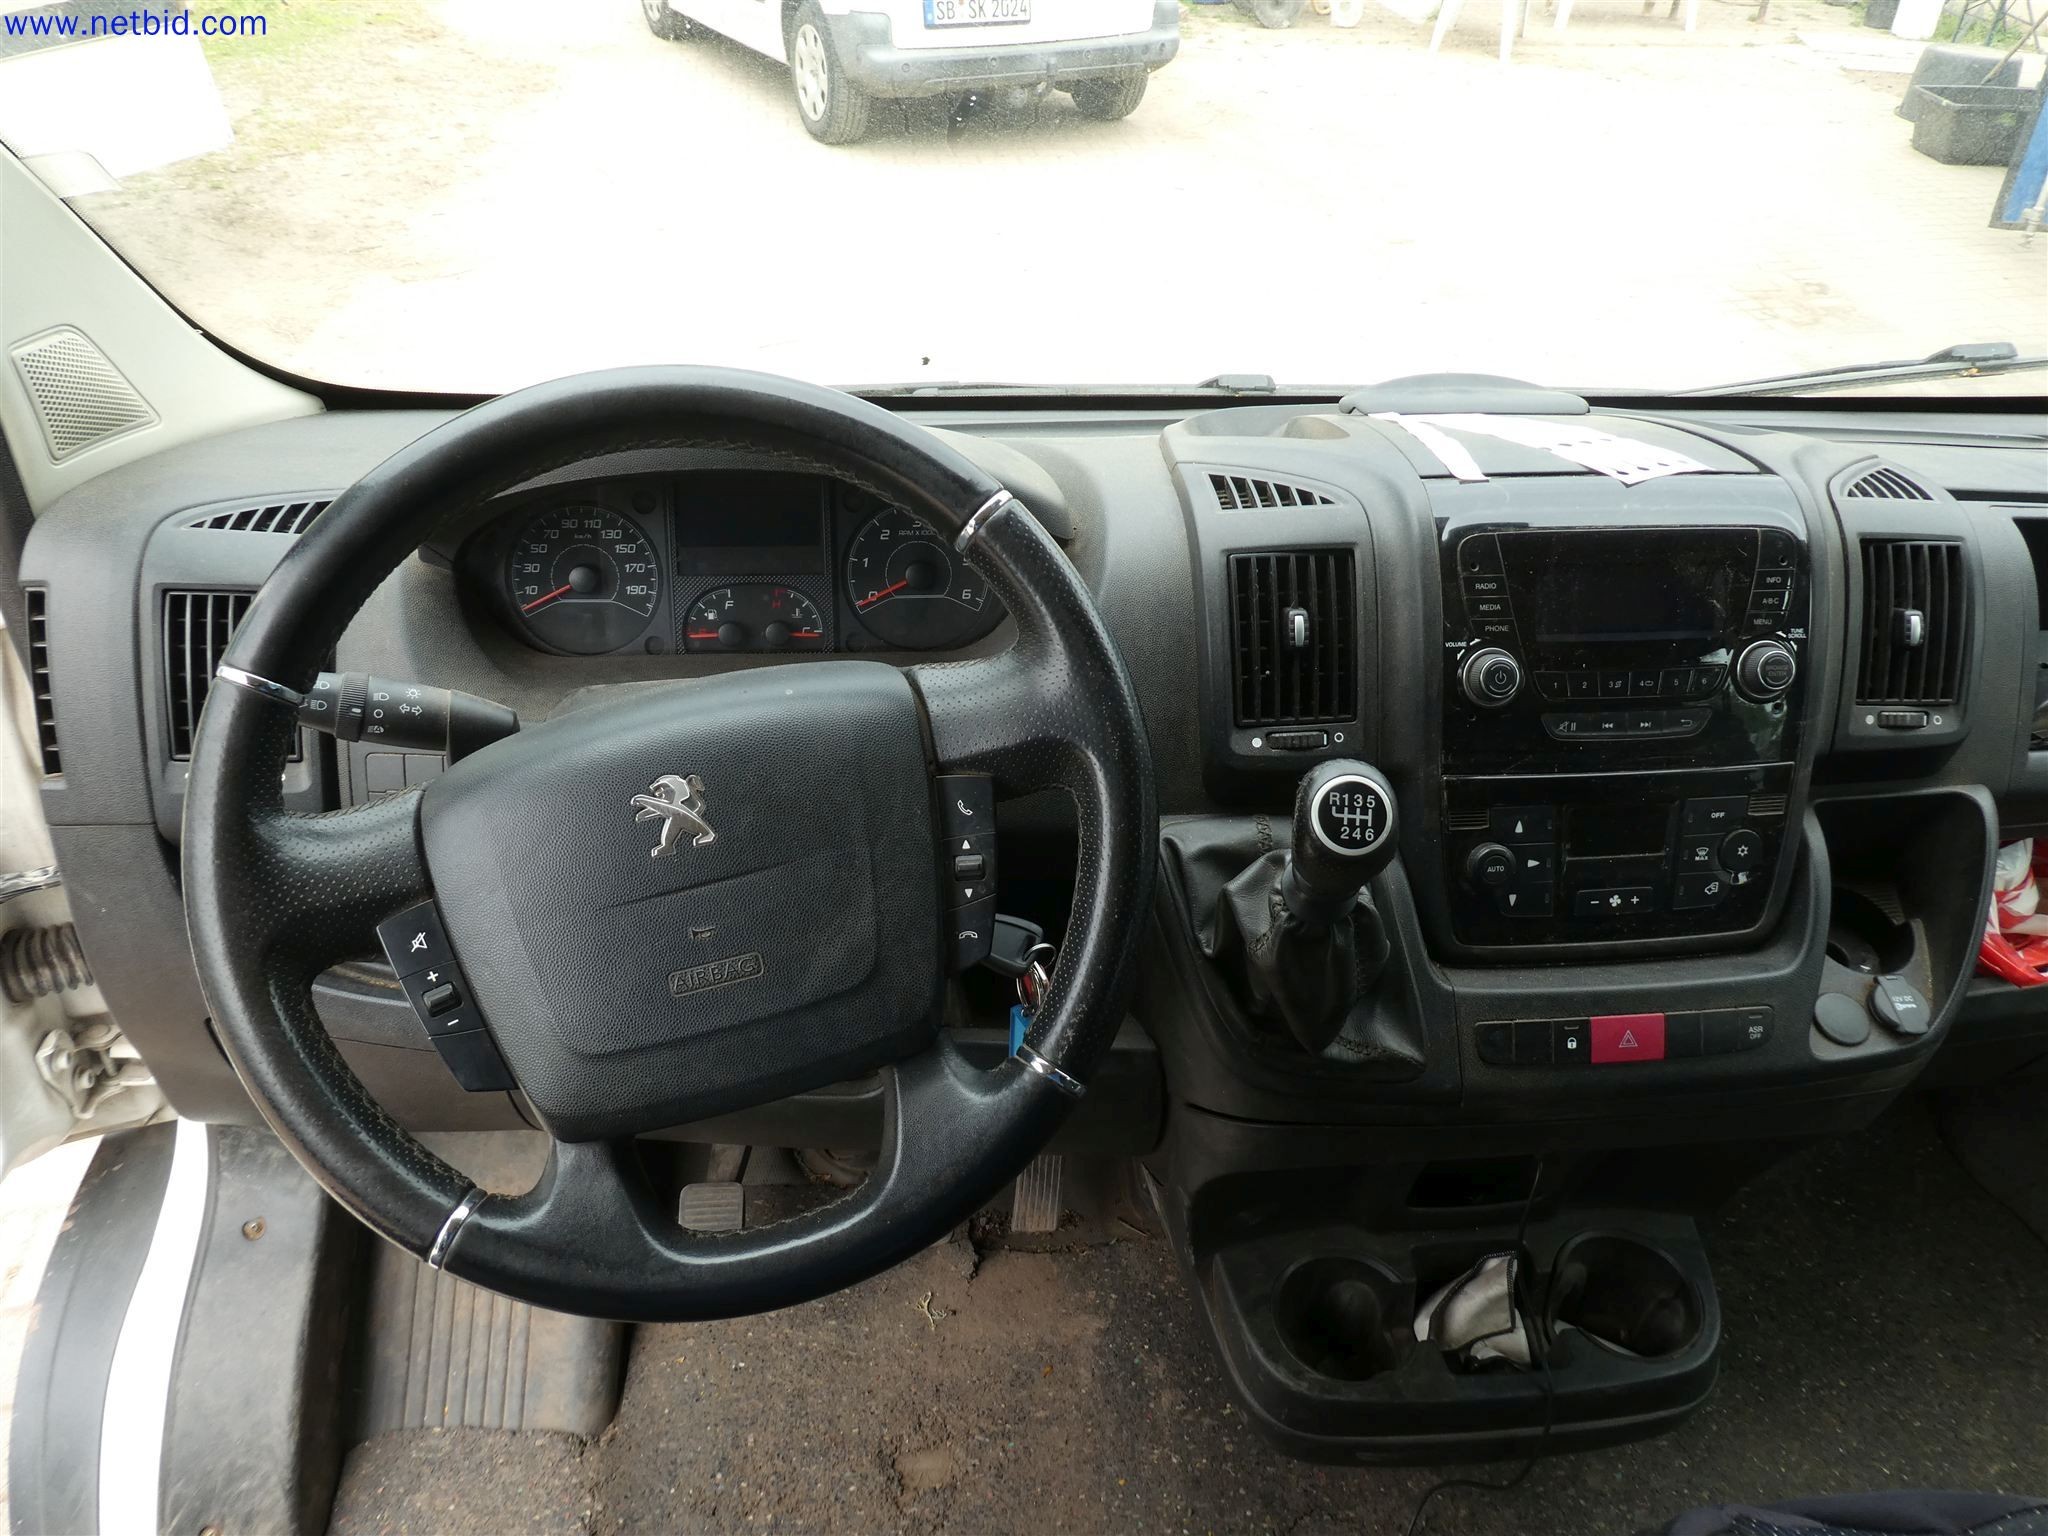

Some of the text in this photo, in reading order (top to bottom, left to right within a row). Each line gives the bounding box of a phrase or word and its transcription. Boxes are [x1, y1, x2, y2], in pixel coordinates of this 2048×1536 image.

[936, 0, 1027, 20] SB SK 2024
[561, 519, 578, 528] 90
[584, 519, 602, 528] 110
[544, 529, 559, 539] 70
[601, 529, 622, 539] 130
[880, 529, 890, 540] 2
[530, 543, 548, 554] 50
[614, 543, 636, 554] 150
[863, 557, 869, 568] 1
[522, 563, 540, 574] 30
[625, 563, 646, 573] 170
[524, 585, 538, 595] 10
[625, 585, 647, 595] 190
[1475, 582, 1497, 590] RADIO
[962, 589, 972, 600] 6
[724, 600, 734, 610] F
[1479, 603, 1502, 611] MEDIA
[1484, 624, 1510, 632] PHONE
[1582, 681, 1588, 689] 2
[1329, 792, 1376, 808] R 1 3 5
[1711, 811, 1726, 819] OFF
[1340, 826, 1375, 841] 2 4 6
[1487, 865, 1505, 873] AUTO
[673, 957, 756, 992] AIRBAG
[1748, 1025, 1764, 1033] ASR
